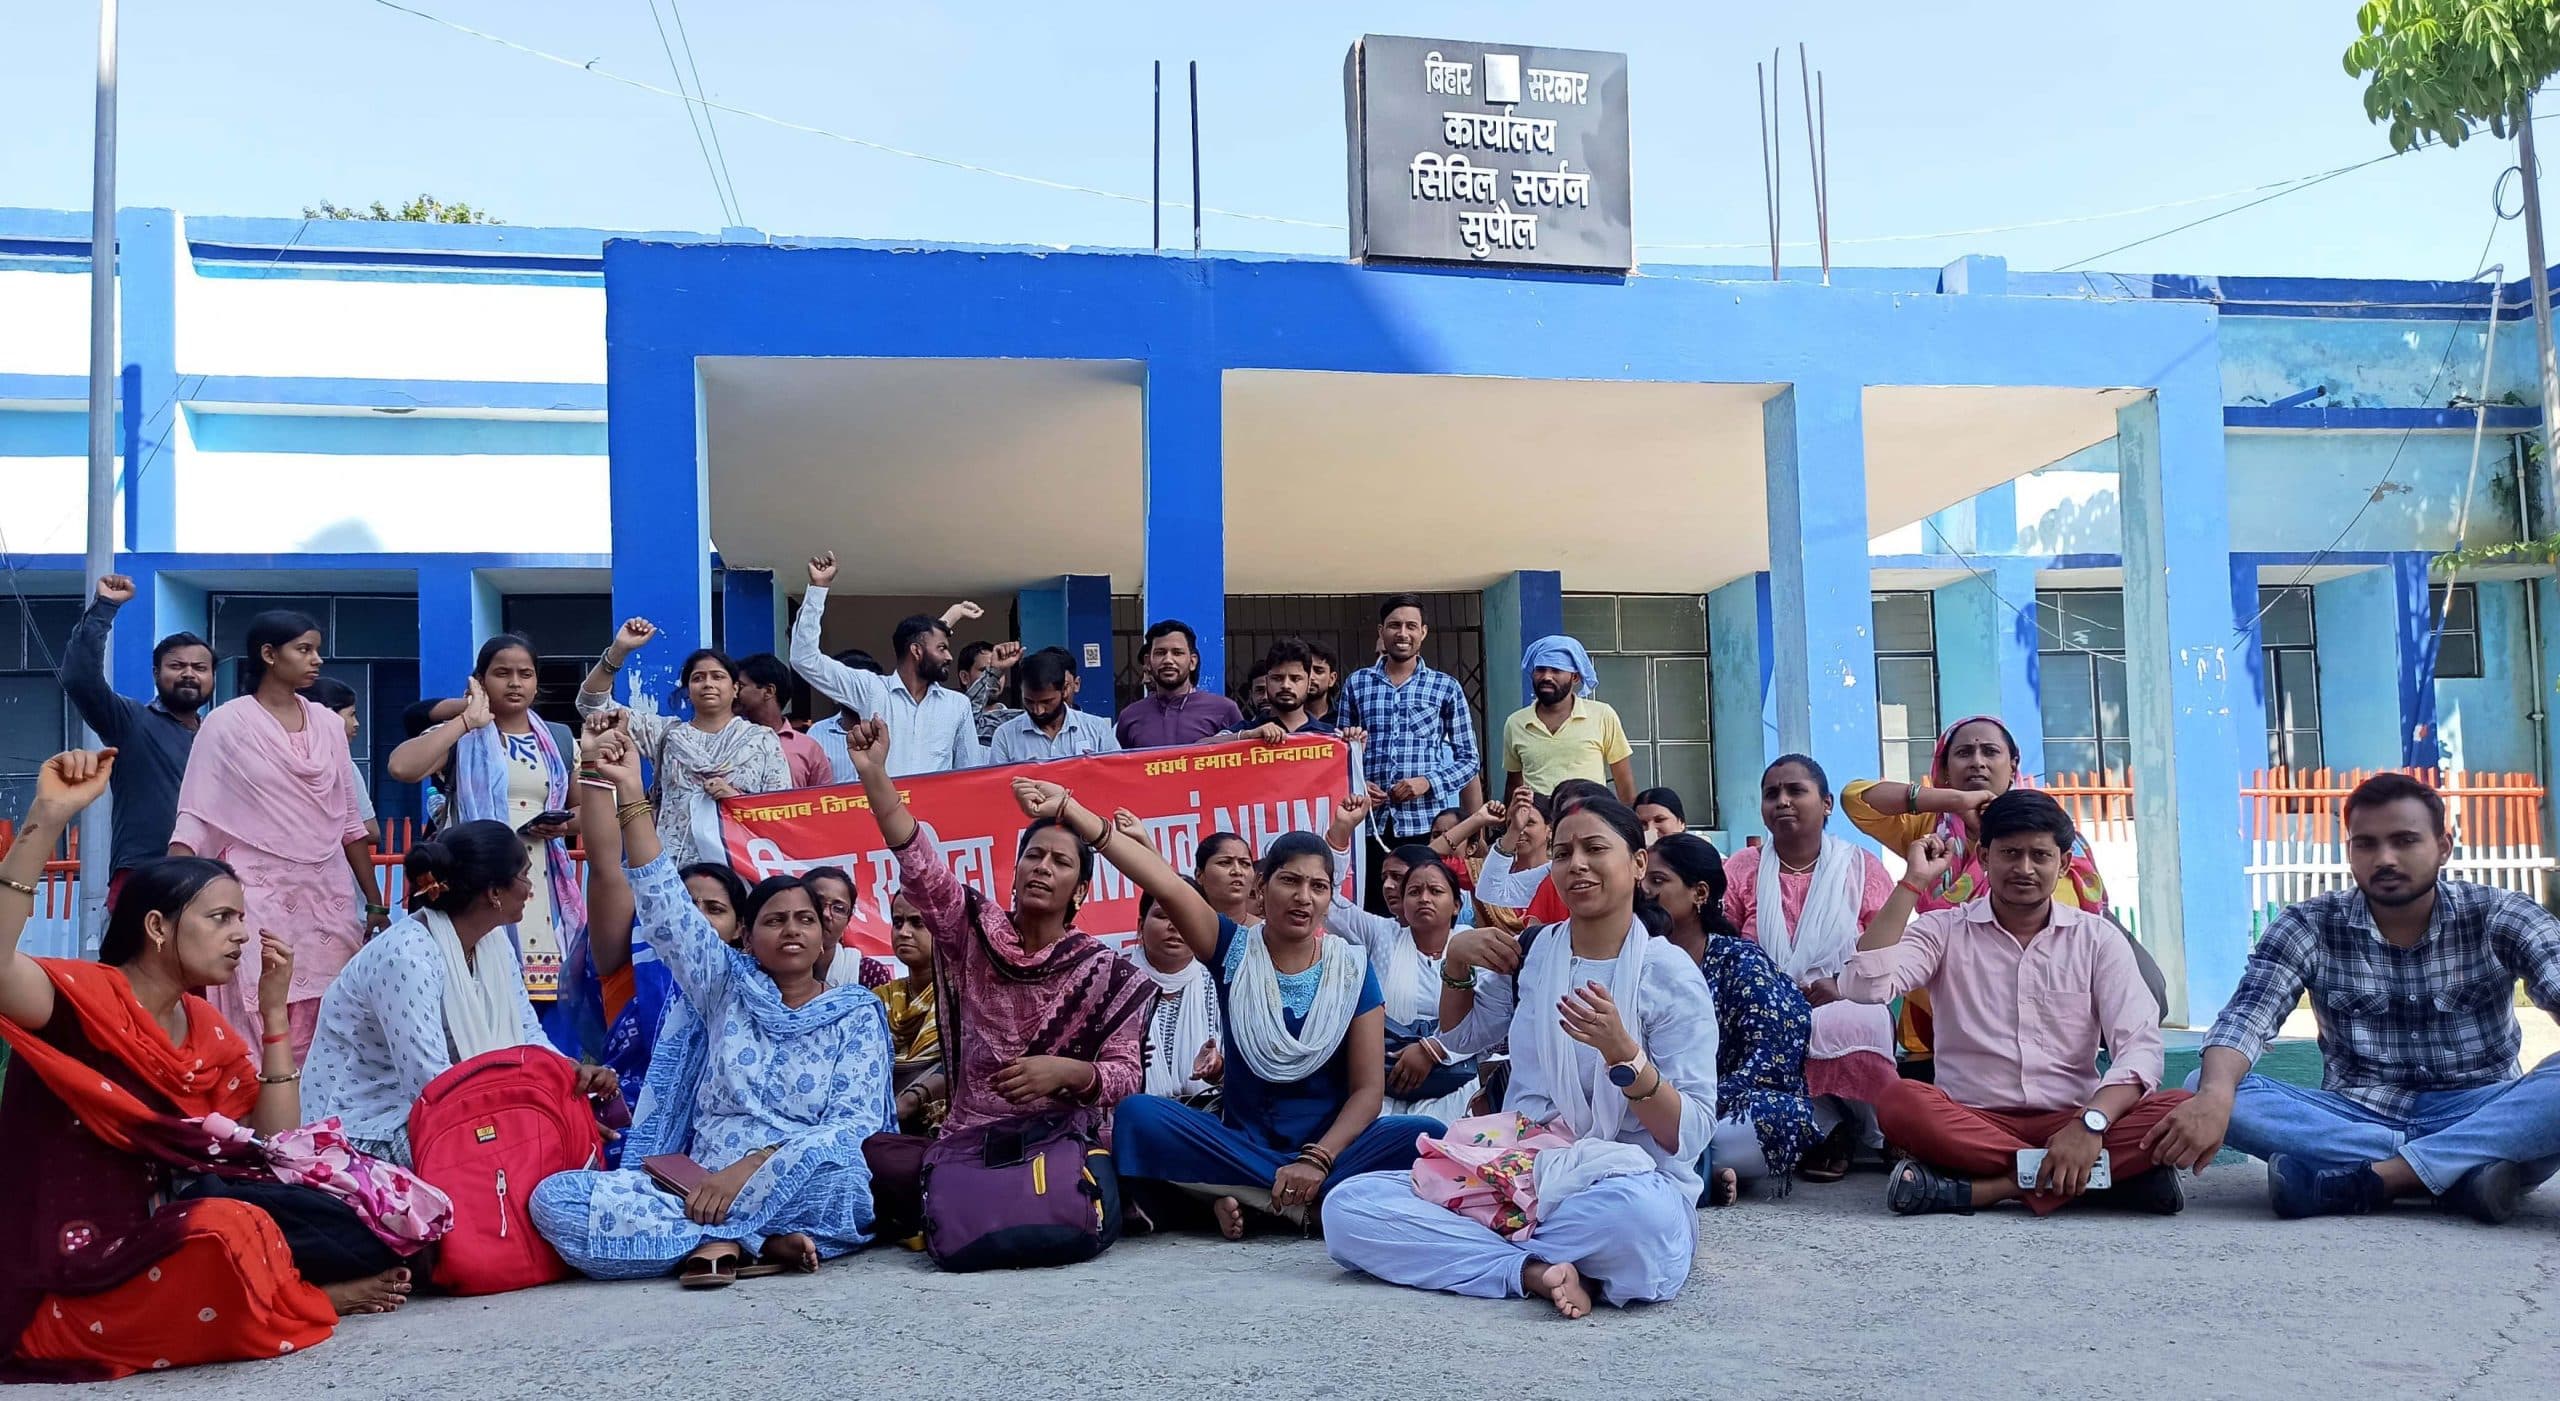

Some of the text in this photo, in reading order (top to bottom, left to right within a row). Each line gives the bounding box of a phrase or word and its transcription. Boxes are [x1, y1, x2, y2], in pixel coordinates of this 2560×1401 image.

[1424, 51, 1589, 105] बिहार सरकार
[1443, 104, 1557, 152] कार्यालय
[1410, 151, 1590, 206] सिविल सर्जन
[1459, 199, 1538, 258] सुपौल
[1144, 755, 1188, 776] संघर्ष
